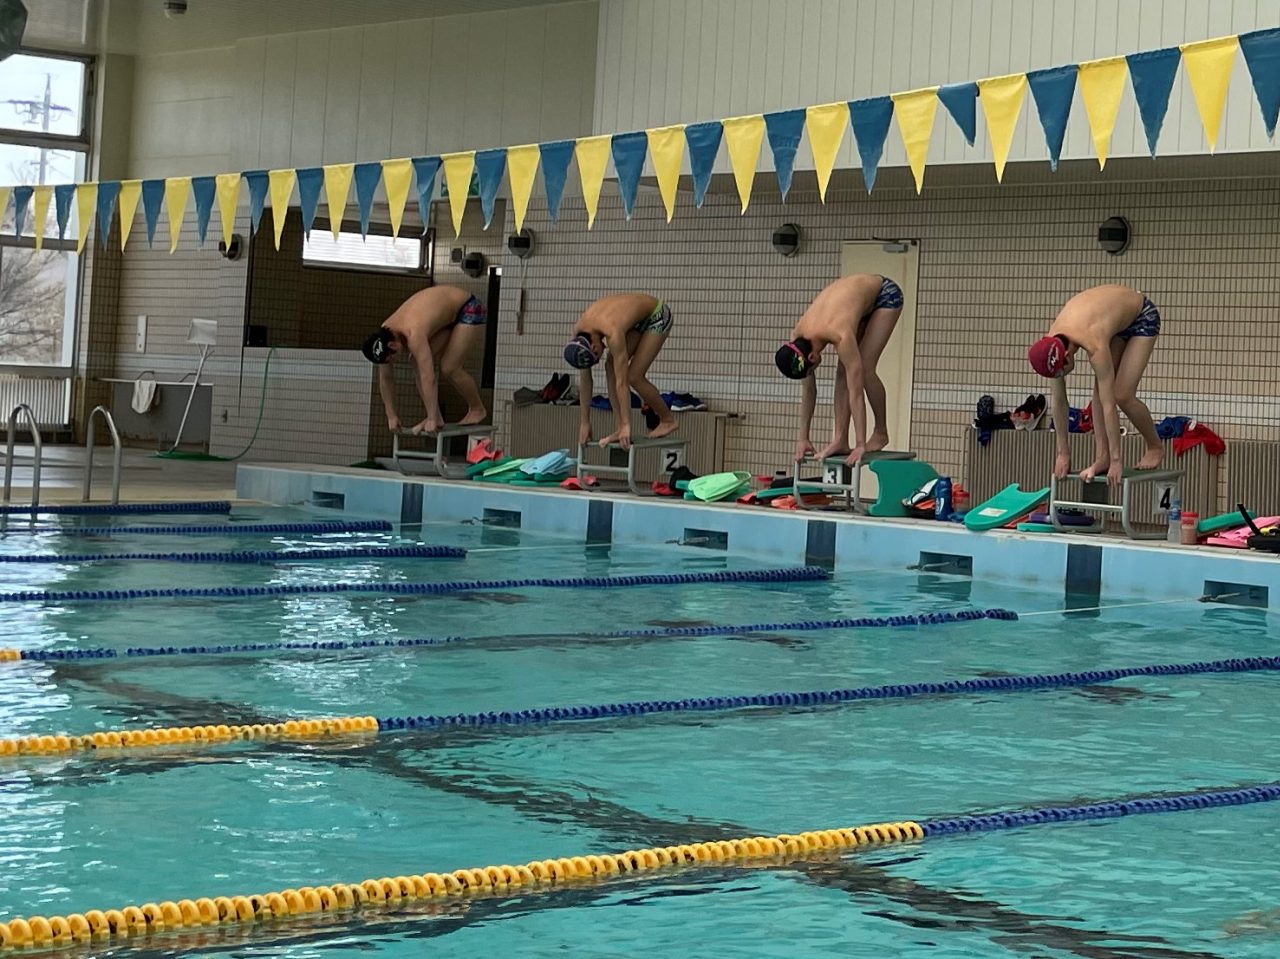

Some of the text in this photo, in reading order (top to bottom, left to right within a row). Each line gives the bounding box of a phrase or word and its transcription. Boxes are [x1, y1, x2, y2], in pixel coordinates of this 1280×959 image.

[665, 452, 678, 472] 2
[827, 467, 838, 485] 3
[1159, 487, 1171, 510] 4
